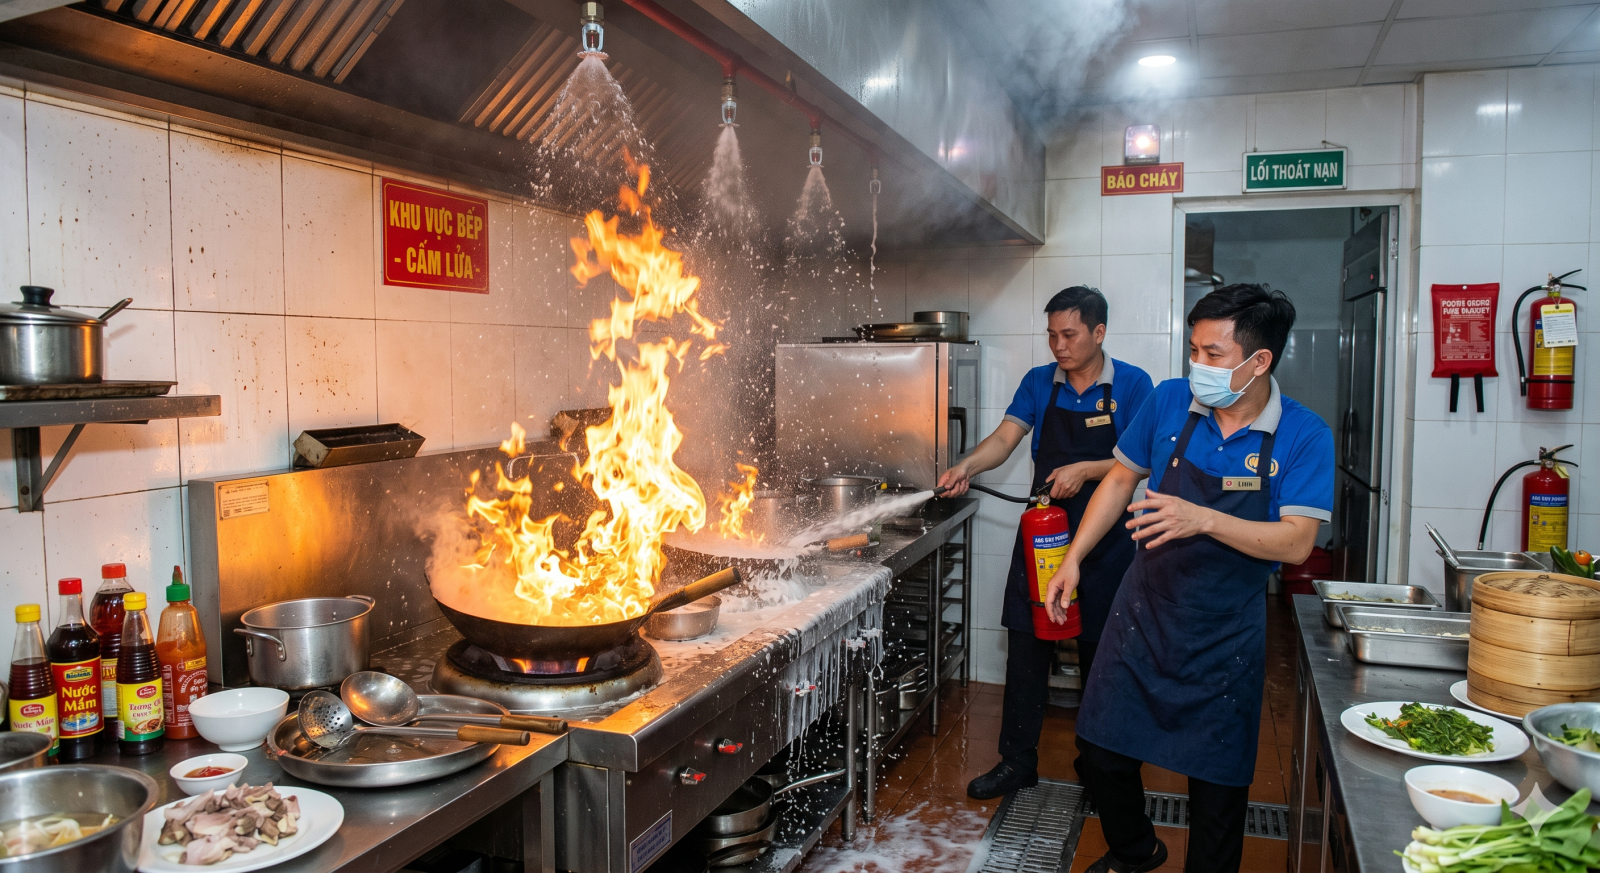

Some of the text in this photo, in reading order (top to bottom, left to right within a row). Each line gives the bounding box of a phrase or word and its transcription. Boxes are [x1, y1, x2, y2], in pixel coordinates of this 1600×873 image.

[1107, 168, 1178, 189] BÁO CHÁY
[1251, 159, 1338, 182] LỐI THOÁT NẠN
[389, 199, 483, 240] KHU VỰC BẾP
[406, 239, 442, 276] CẤM
[445, 244, 474, 280] LỬA
[62, 684, 97, 698] Nước
